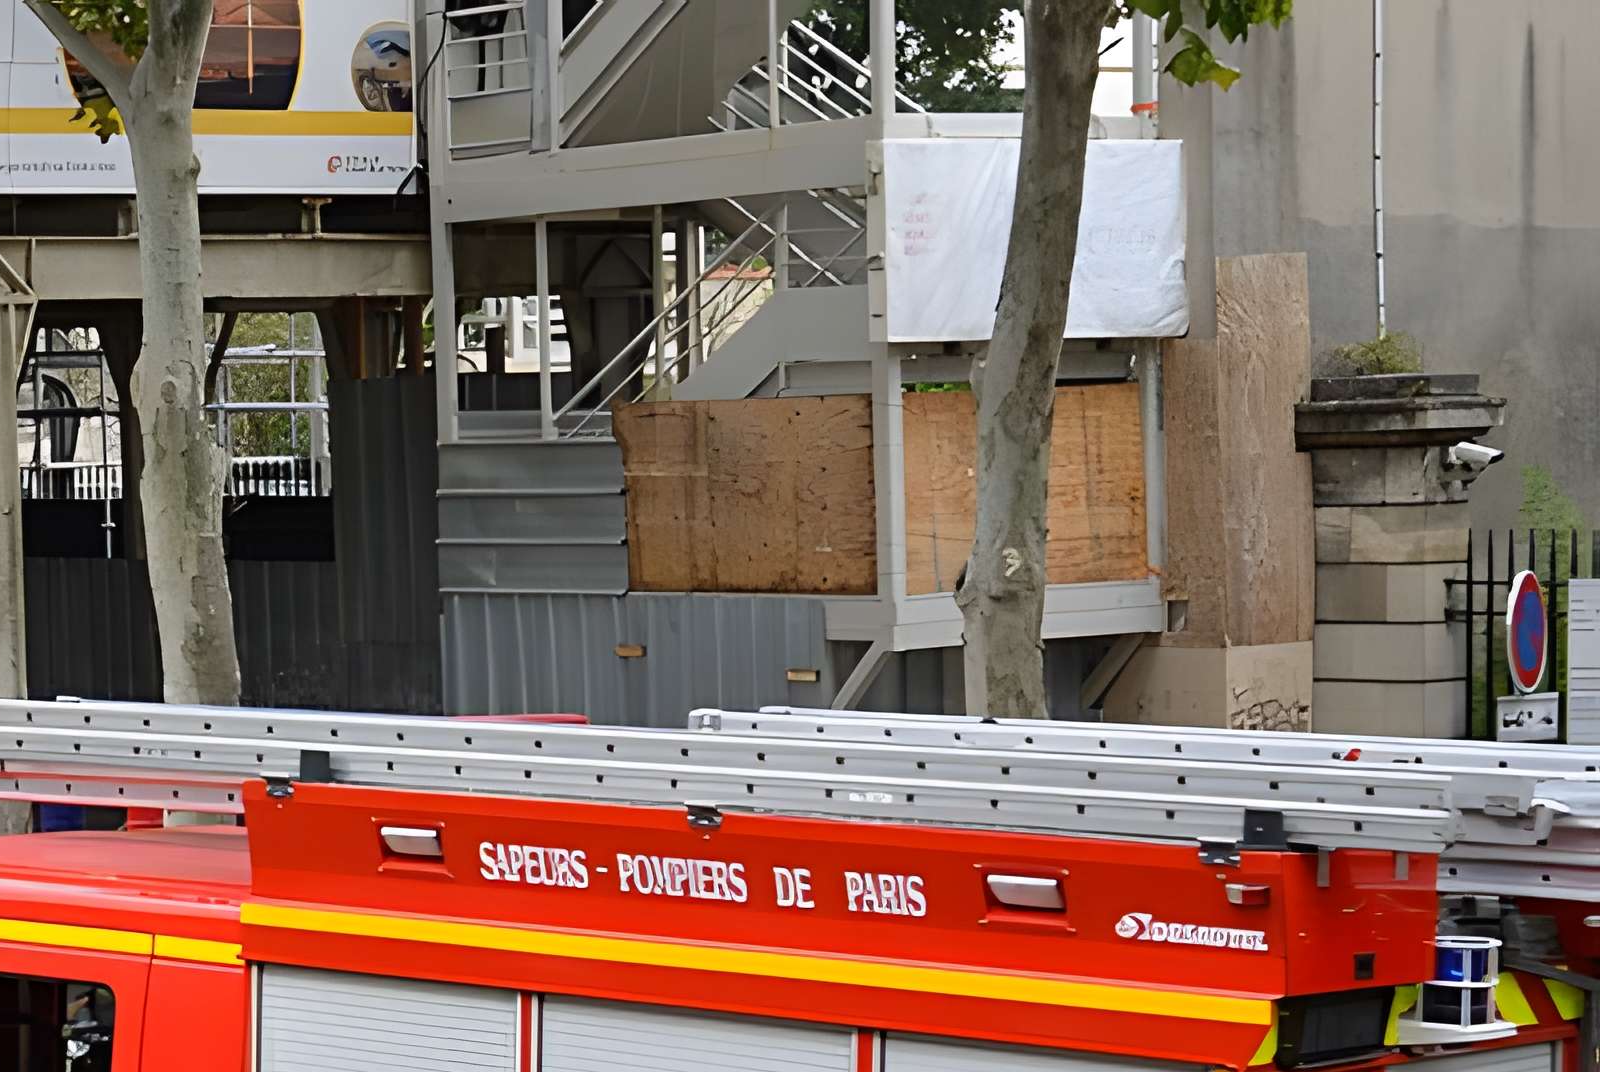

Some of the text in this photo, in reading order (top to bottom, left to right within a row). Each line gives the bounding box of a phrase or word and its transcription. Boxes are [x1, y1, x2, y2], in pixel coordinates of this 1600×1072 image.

[478, 841, 589, 889] SAPEURS
[616, 852, 749, 903] POMPIERS
[772, 866, 816, 909] DE
[844, 871, 928, 917] PARIS
